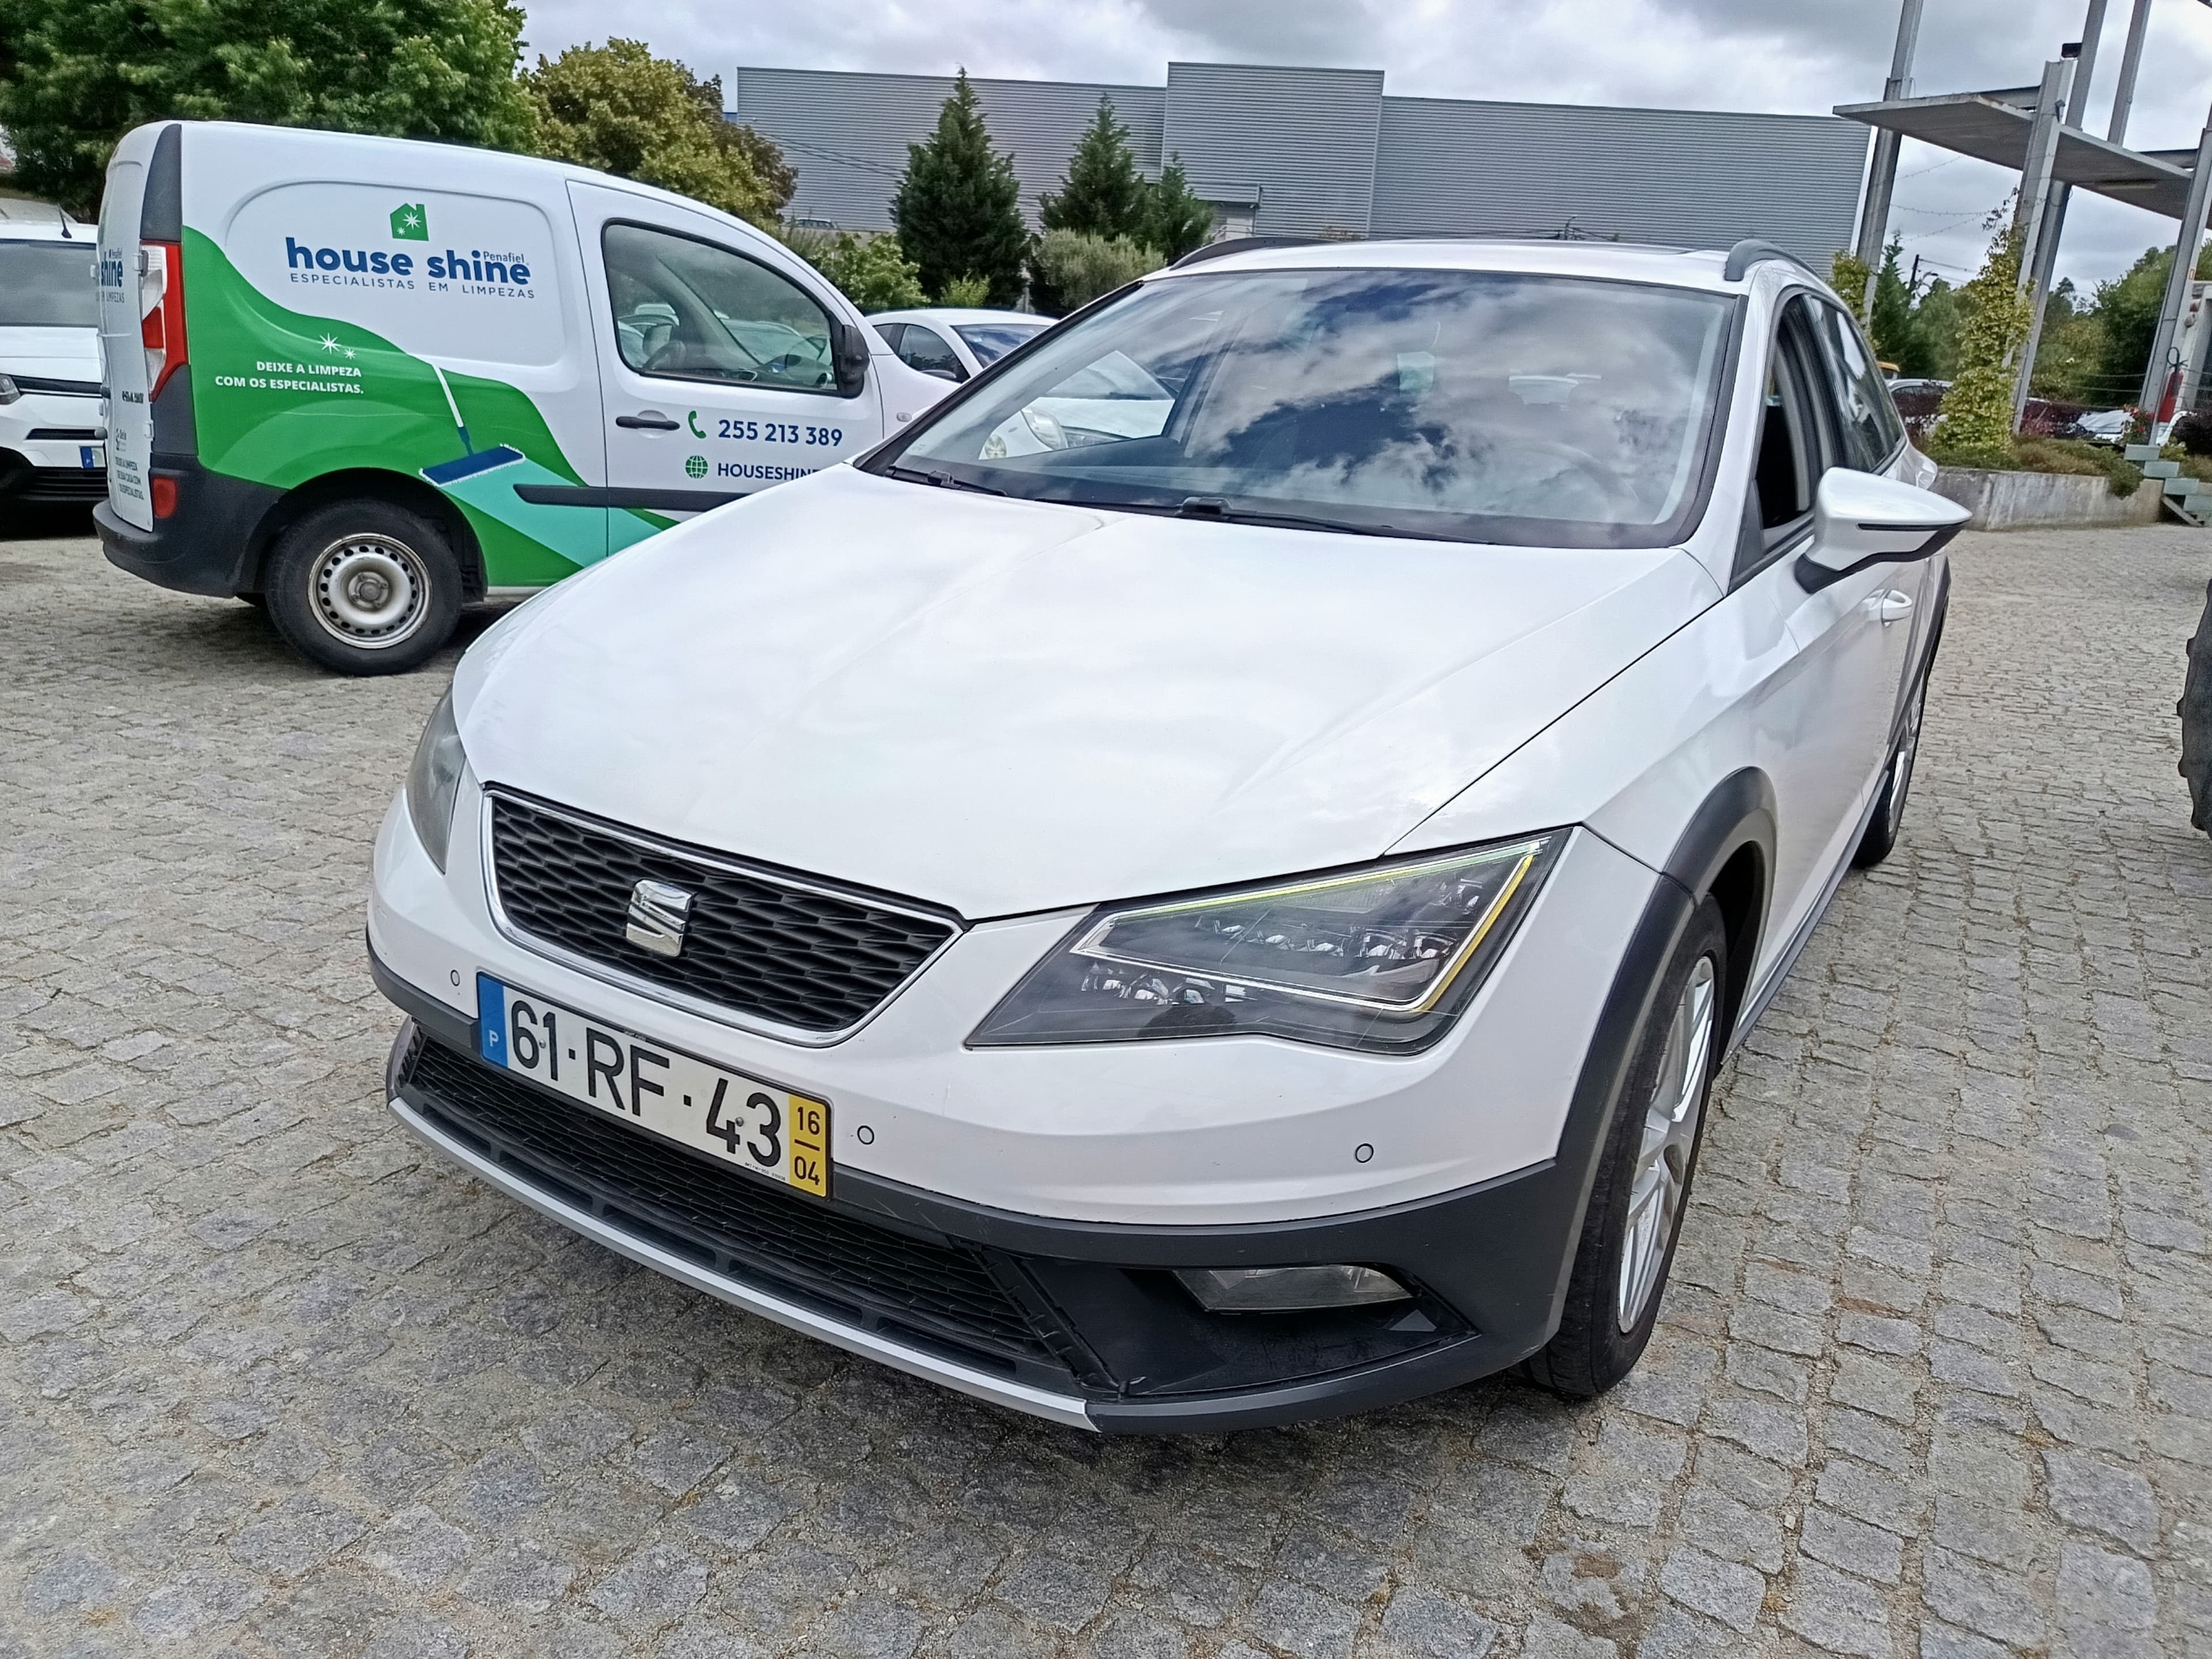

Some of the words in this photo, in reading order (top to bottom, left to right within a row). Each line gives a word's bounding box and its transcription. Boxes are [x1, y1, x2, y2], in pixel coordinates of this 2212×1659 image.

[285, 237, 414, 276] house
[427, 249, 531, 285] shine
[483, 251, 525, 263] Penafiel
[290, 272, 415, 289] ESPECIALISTAS
[429, 282, 449, 292] EM
[462, 284, 535, 298] LIMPEZAS
[256, 361, 293, 373] DEIXE
[296, 363, 305, 373] A
[308, 364, 362, 377] LIMPEZA
[215, 376, 246, 388] COM
[249, 377, 267, 388] OS
[270, 379, 364, 395] ESPECIALISTAS.
[718, 419, 759, 441] 255
[764, 423, 800, 444] 213
[805, 426, 843, 447] 389
[717, 463, 821, 481] HOUSESHIN
[488, 1029, 499, 1047] P
[797, 1106, 821, 1135] 16
[794, 1156, 820, 1186] 04
